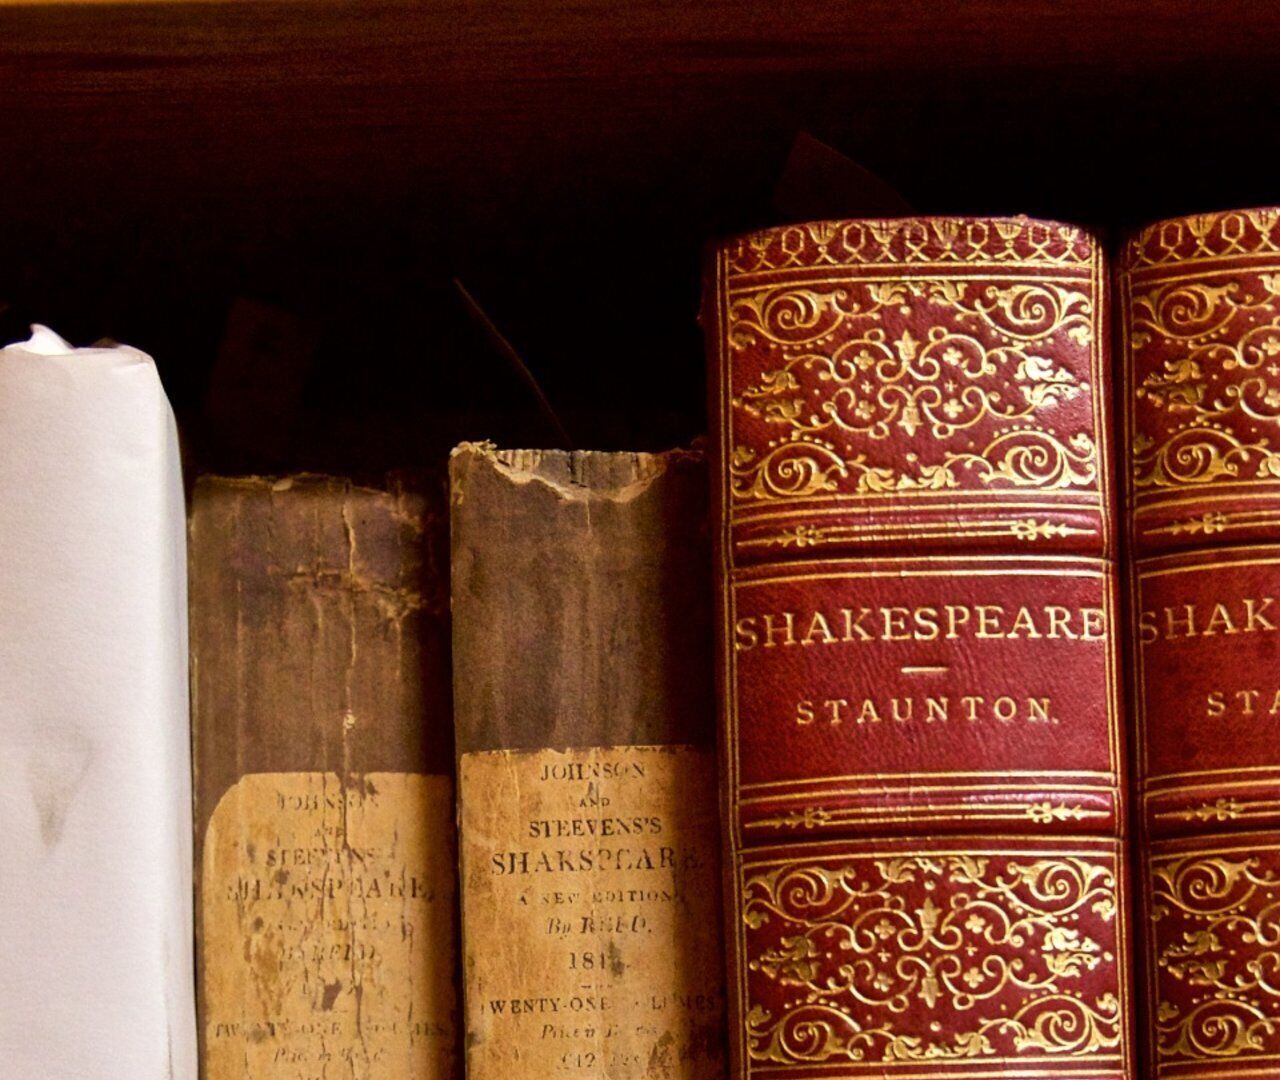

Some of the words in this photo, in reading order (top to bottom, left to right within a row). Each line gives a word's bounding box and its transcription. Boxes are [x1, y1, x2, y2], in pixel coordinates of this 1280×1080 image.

[734, 604, 1109, 650] SHAKESPEARE
[796, 696, 1060, 725] STAUNTON.
[540, 761, 646, 782] JOHNSON
[578, 796, 612, 808] AND
[528, 817, 663, 839] STEEVENS'S
[568, 951, 632, 971] 181.
[480, 996, 613, 1016] WENTY-ONE
